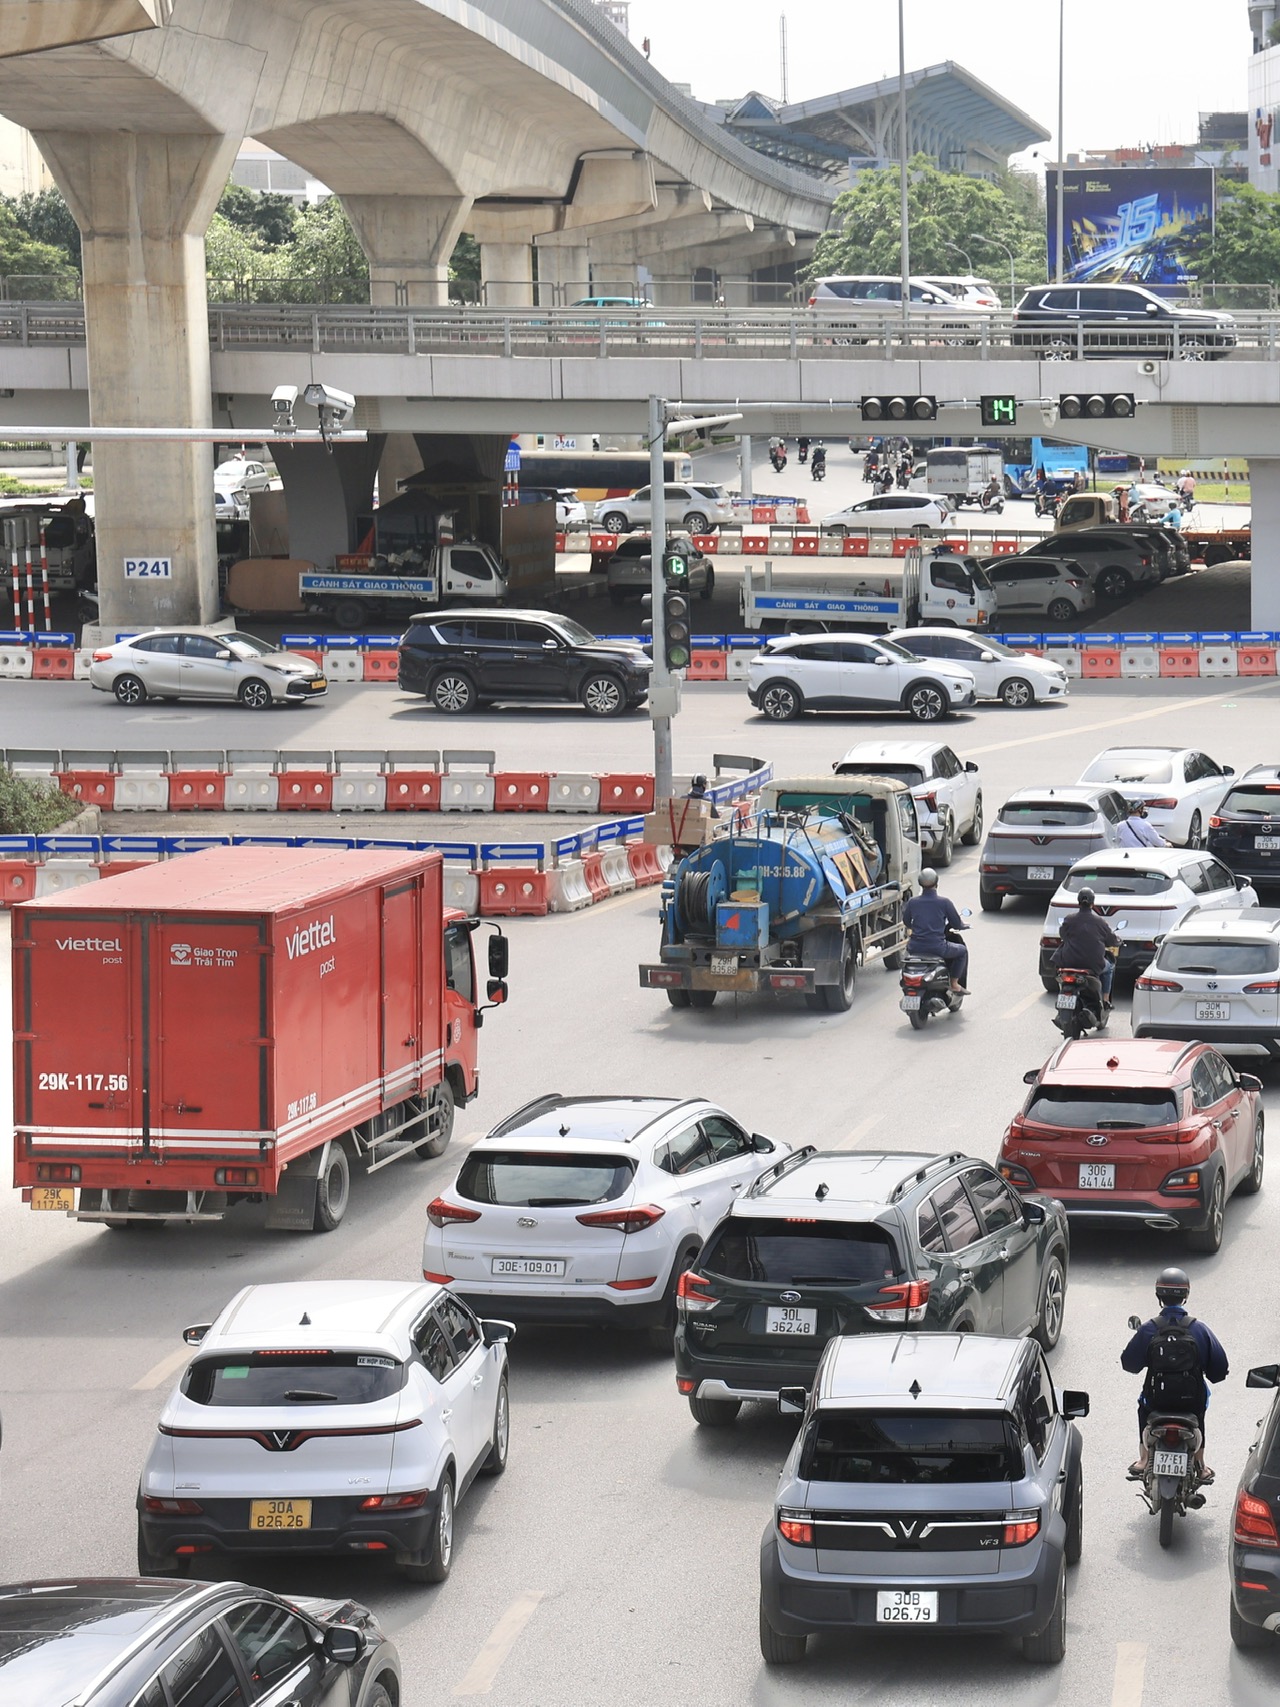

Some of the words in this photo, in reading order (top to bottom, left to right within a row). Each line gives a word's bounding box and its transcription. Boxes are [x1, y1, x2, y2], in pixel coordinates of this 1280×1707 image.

[993, 400, 1014, 421] 14
[126, 560, 169, 577] P241
[312, 578, 340, 588] CẢNH
[342, 579, 362, 589] SÁT
[364, 581, 394, 590] GIAO
[775, 600, 797, 609] CẢNH
[804, 601, 820, 609] SÁT
[827, 602, 846, 610] GIAO
[853, 602, 880, 612] THÔNG
[286, 915, 336, 960] viettel
[55, 937, 123, 952] viettel
[194, 947, 214, 957] Giao
[216, 947, 237, 960] Trọn
[102, 956, 123, 965] post
[194, 957, 213, 967] Trái
[216, 957, 234, 967] Tim
[320, 955, 336, 979] post
[712, 965, 737, 975] 335.88
[1205, 1002, 1220, 1010] 30M
[1199, 1010, 1226, 1019] 995.91
[38, 1072, 128, 1091] 29K-117.56
[287, 1092, 317, 1120] 29K-117.56
[1088, 1165, 1107, 1176] 30G
[1080, 1176, 1113, 1189] 341.44
[43, 1188, 62, 1200] 29K
[37, 1200, 69, 1210] 117.56
[498, 1261, 558, 1273] 30E-109.01
[781, 1308, 802, 1321] 30L
[772, 1321, 811, 1334] 362.48
[358, 1356, 366, 1364] XE
[1160, 1453, 1182, 1465] 37-E1
[1156, 1464, 1184, 1475] 101.04
[269, 1501, 294, 1514] 30A
[257, 1515, 304, 1528] 826.26
[894, 1592, 921, 1606] 30B
[883, 1607, 931, 1621] 026.79
